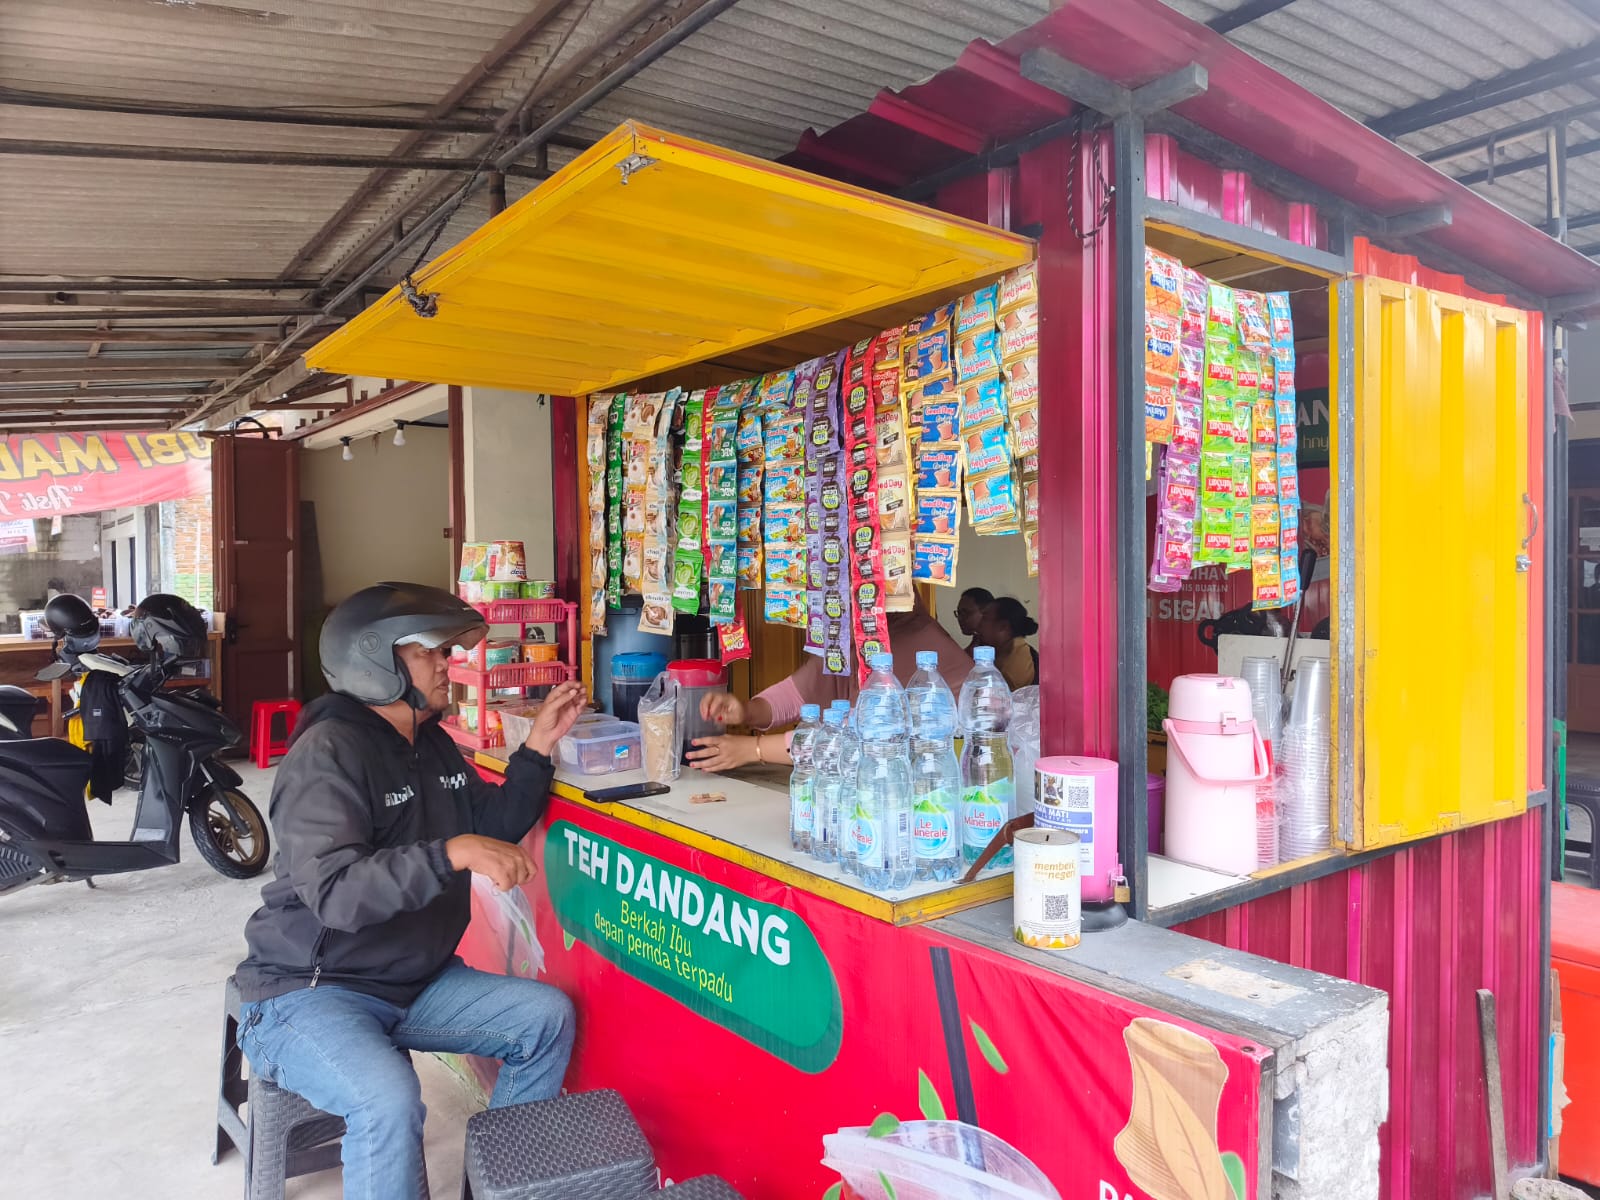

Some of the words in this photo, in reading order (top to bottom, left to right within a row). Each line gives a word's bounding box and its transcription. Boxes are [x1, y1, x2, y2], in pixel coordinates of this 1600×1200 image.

[920, 818, 932, 829] Le
[964, 815, 1001, 828] Minerale
[973, 808, 985, 818] Le
[564, 828, 609, 885] TEH
[615, 851, 791, 966] DANDANG
[620, 900, 666, 944] Berkah
[669, 924, 692, 958] Ibu
[595, 909, 624, 945] depan
[628, 932, 671, 971] pemda
[675, 957, 733, 1003] terpadu
